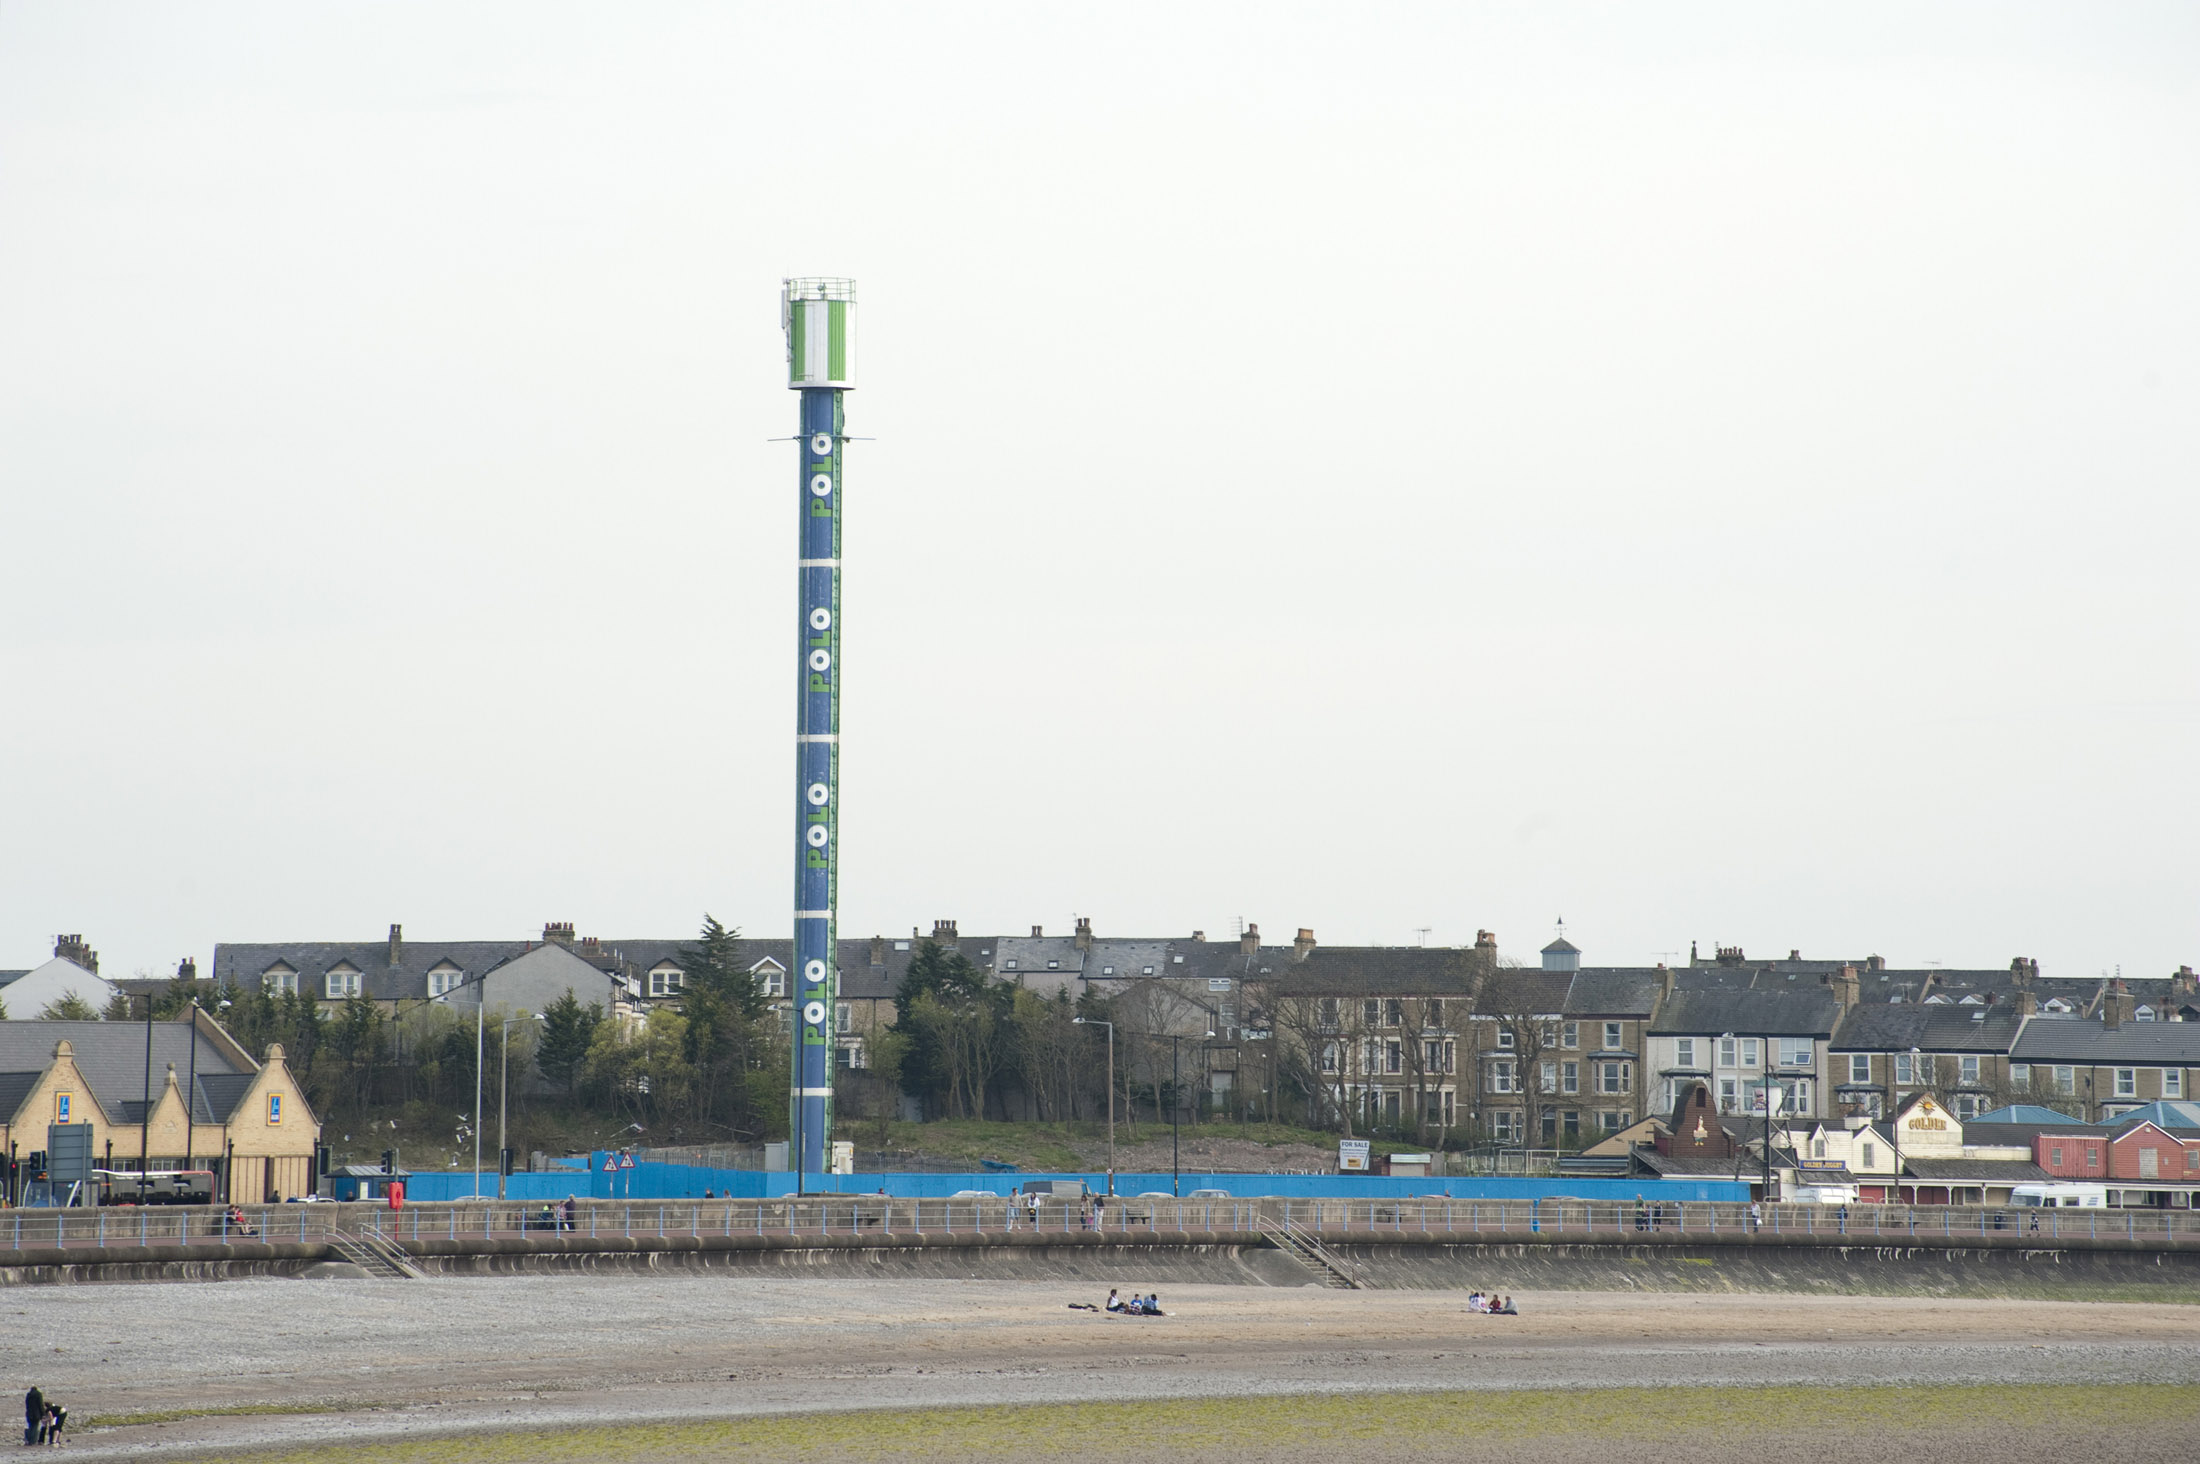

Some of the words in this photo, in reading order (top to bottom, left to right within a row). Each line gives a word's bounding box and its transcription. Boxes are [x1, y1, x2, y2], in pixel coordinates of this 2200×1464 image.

[810, 432, 833, 517] POLO
[808, 606, 831, 693] POLO
[806, 782, 829, 869] POLO
[803, 958, 827, 1045] POLO
